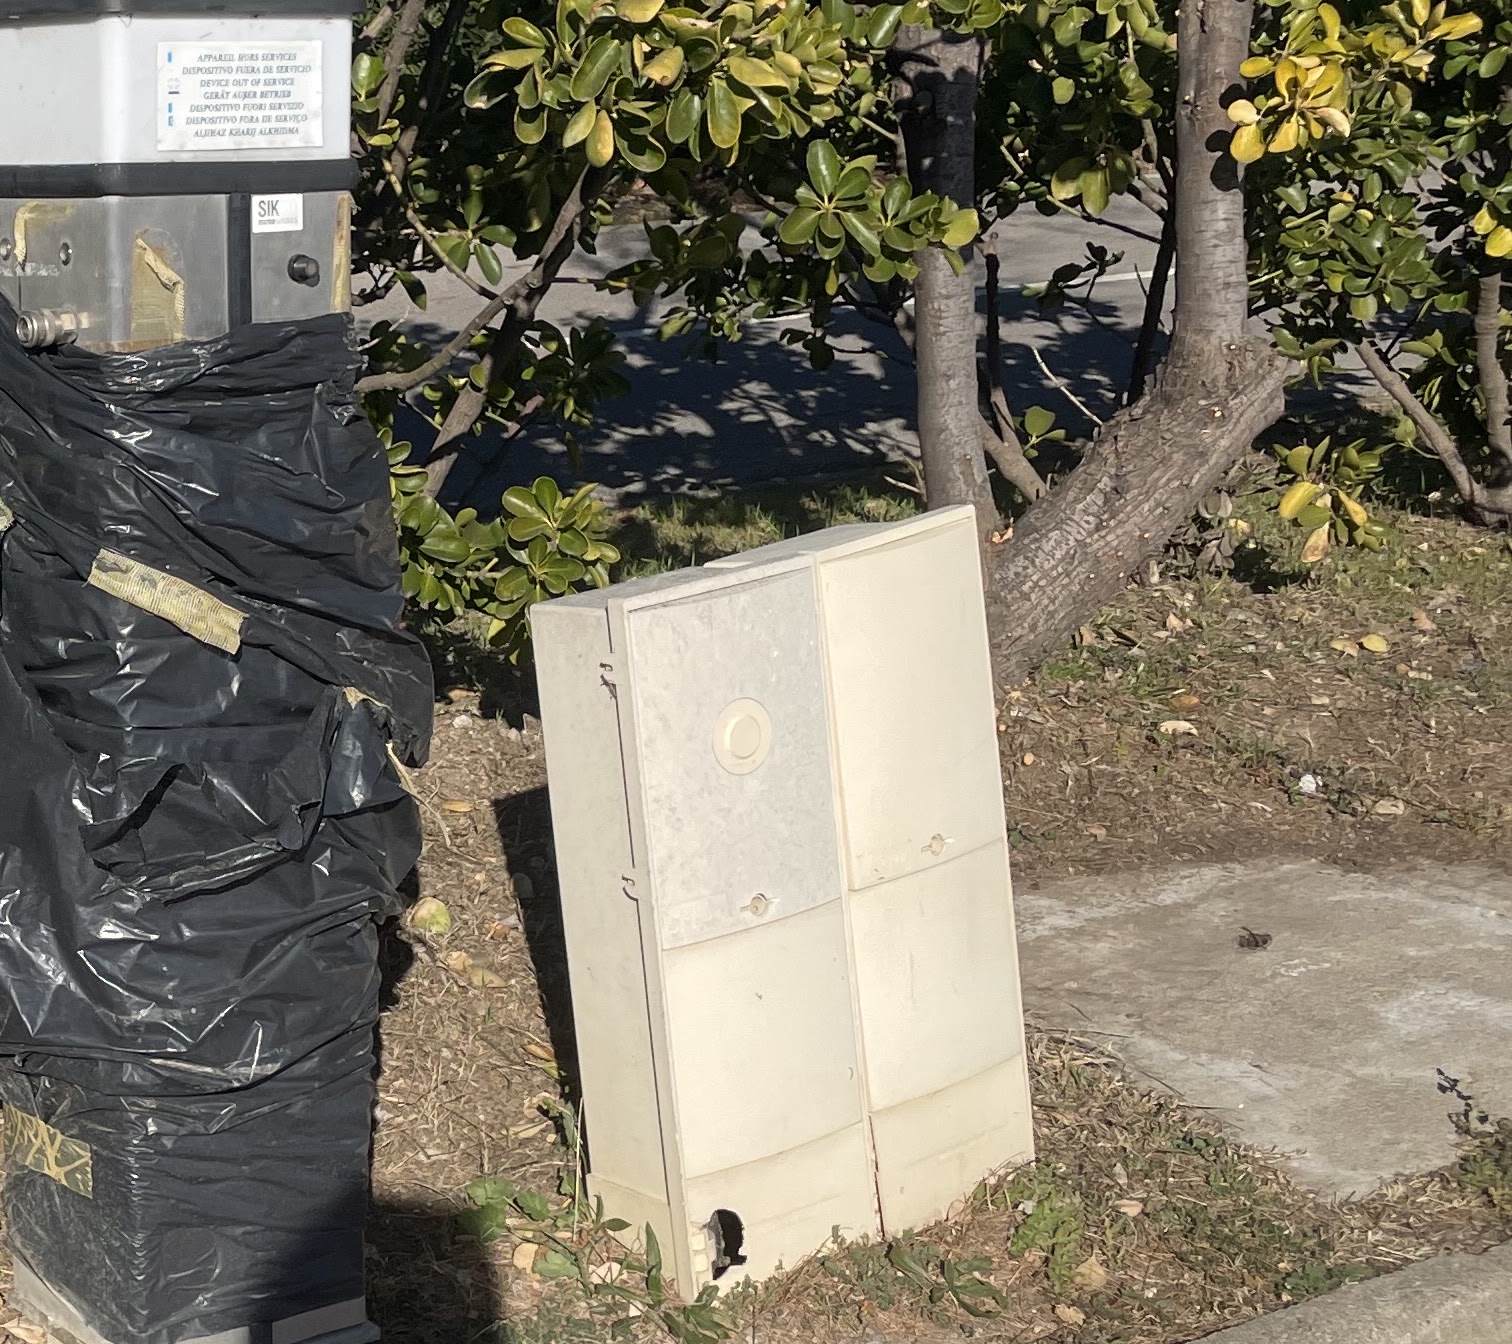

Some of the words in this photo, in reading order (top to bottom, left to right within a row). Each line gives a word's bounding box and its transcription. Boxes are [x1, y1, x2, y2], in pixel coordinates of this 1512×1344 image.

[197, 54, 235, 62] APPAREIL
[261, 53, 297, 61] SERVICES
[182, 66, 233, 74] DISPOSITIVO
[263, 66, 273, 74] DE
[200, 79, 230, 87] DEVICE
[263, 78, 295, 86] SERVICE
[189, 104, 240, 112] DISPOSITIVO
[243, 103, 266, 111] FUORI
[186, 116, 237, 125] DISPOSITIVO
[239, 116, 259, 124] FORA
[262, 115, 273, 123] DE
[258, 200, 280, 217] SIK
